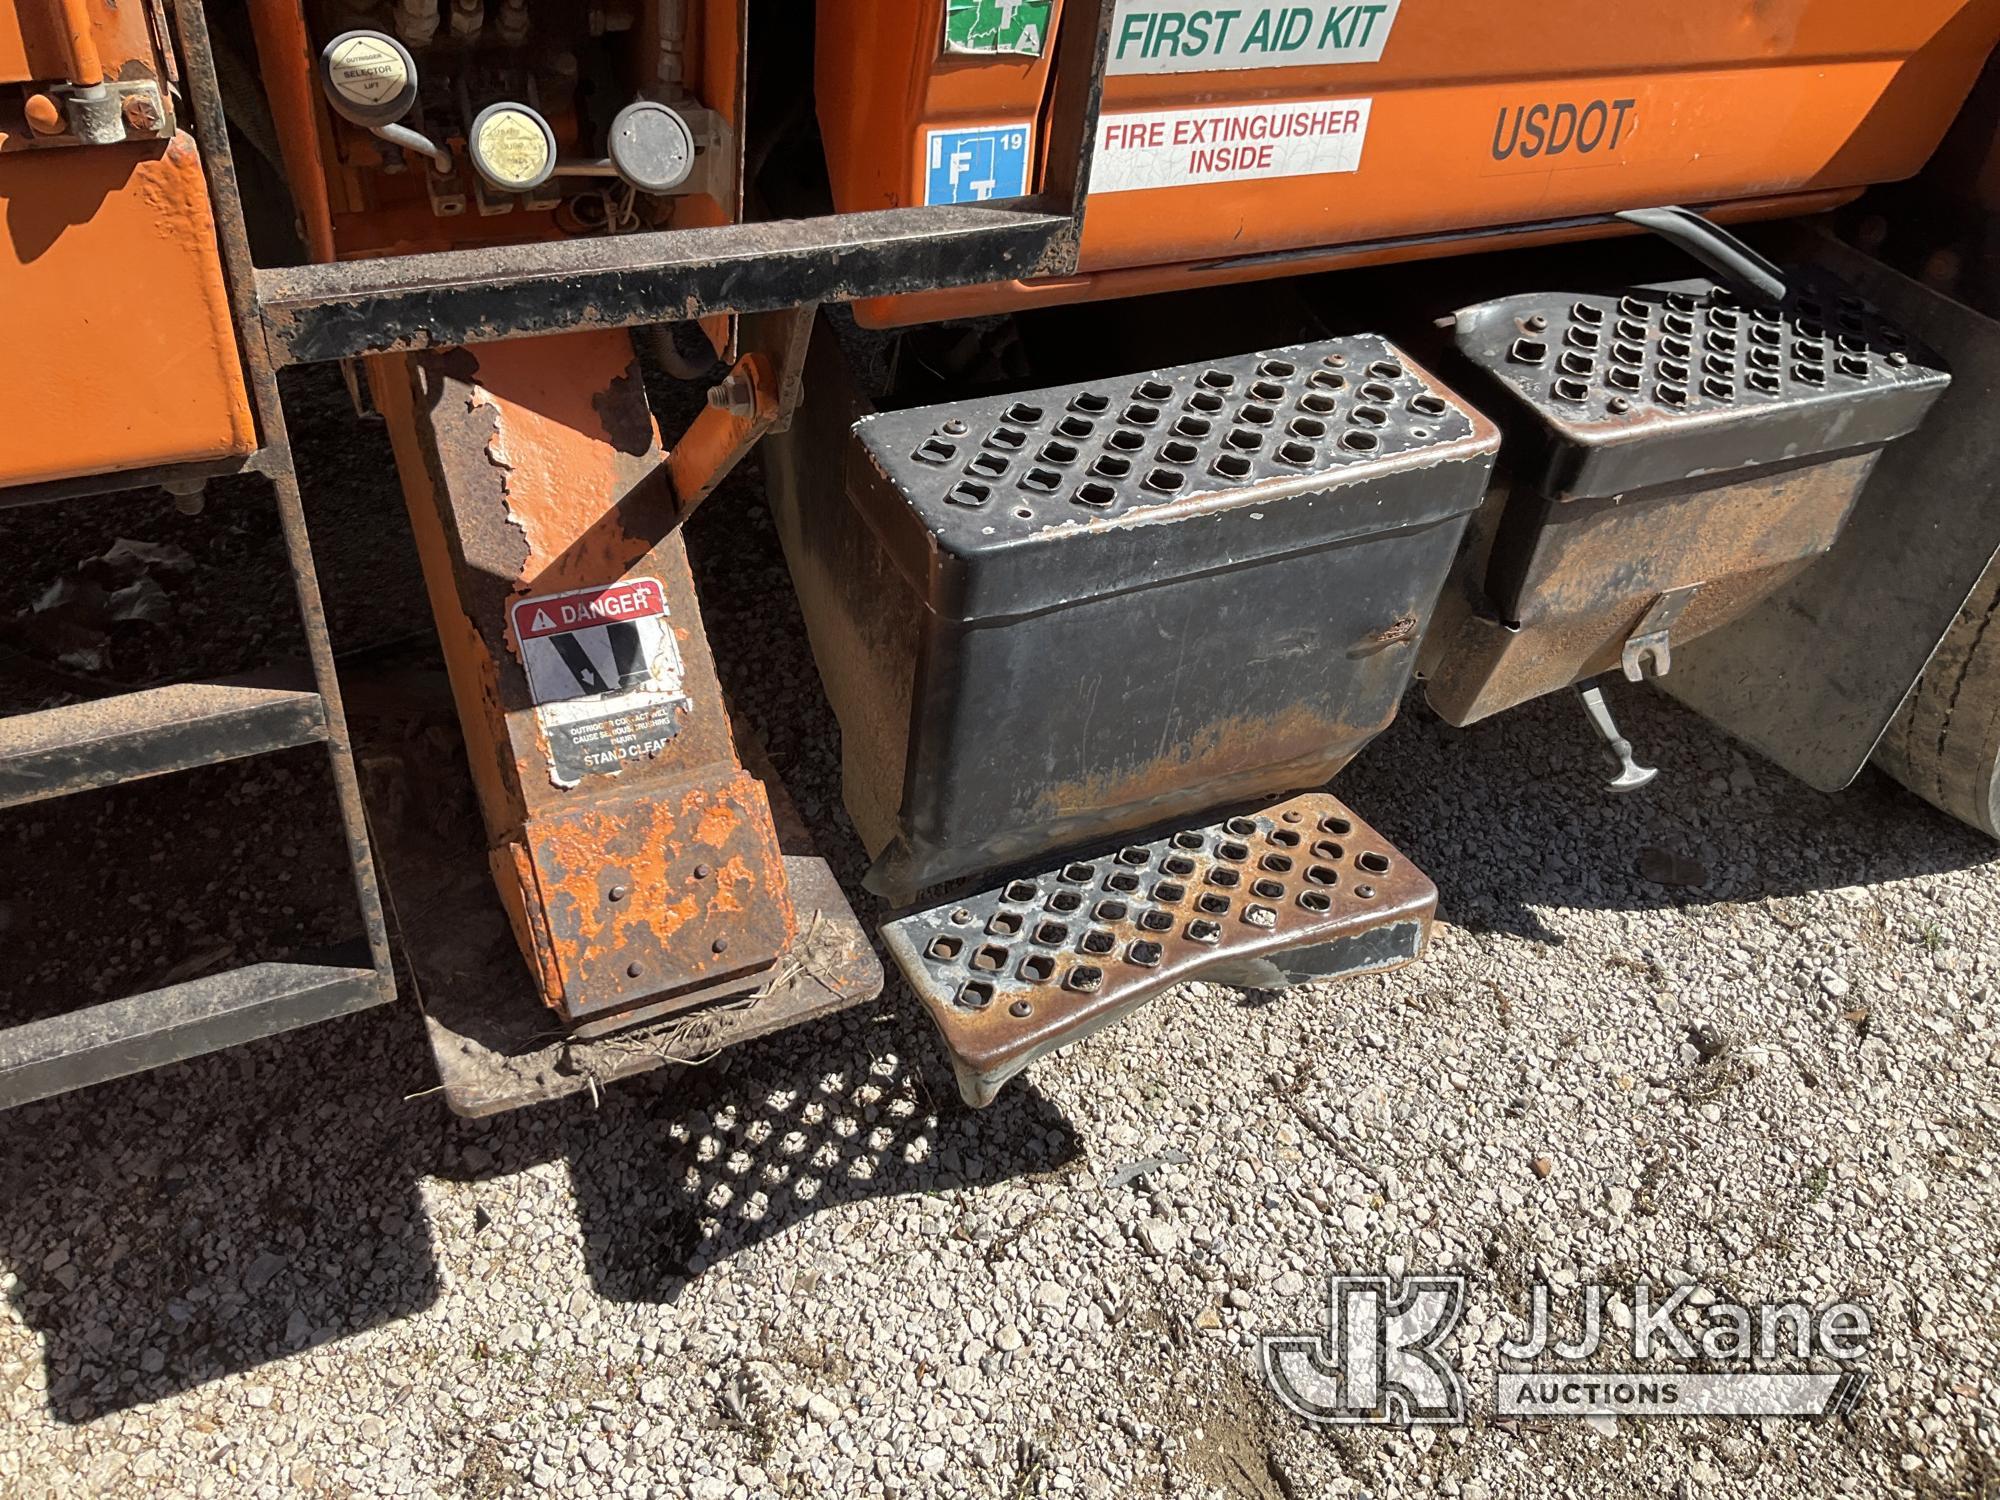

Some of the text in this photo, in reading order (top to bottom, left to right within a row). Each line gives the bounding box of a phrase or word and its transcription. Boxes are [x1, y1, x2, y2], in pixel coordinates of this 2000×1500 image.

[1115, 4, 1388, 60] FIRST AID KIT
[343, 65, 392, 78] SELECTOR
[363, 81, 379, 90] LIFT
[1104, 110, 1360, 150] FIRE EXTINGUISHER
[1492, 99, 1636, 161] USDOT
[1000, 133, 1022, 150] 19
[1189, 144, 1274, 174] INSIDE
[560, 590, 650, 625] DANGER
[570, 720, 614, 736] OUTRIGGR
[572, 733, 599, 745] CAUSE
[583, 748, 627, 767] STAND
